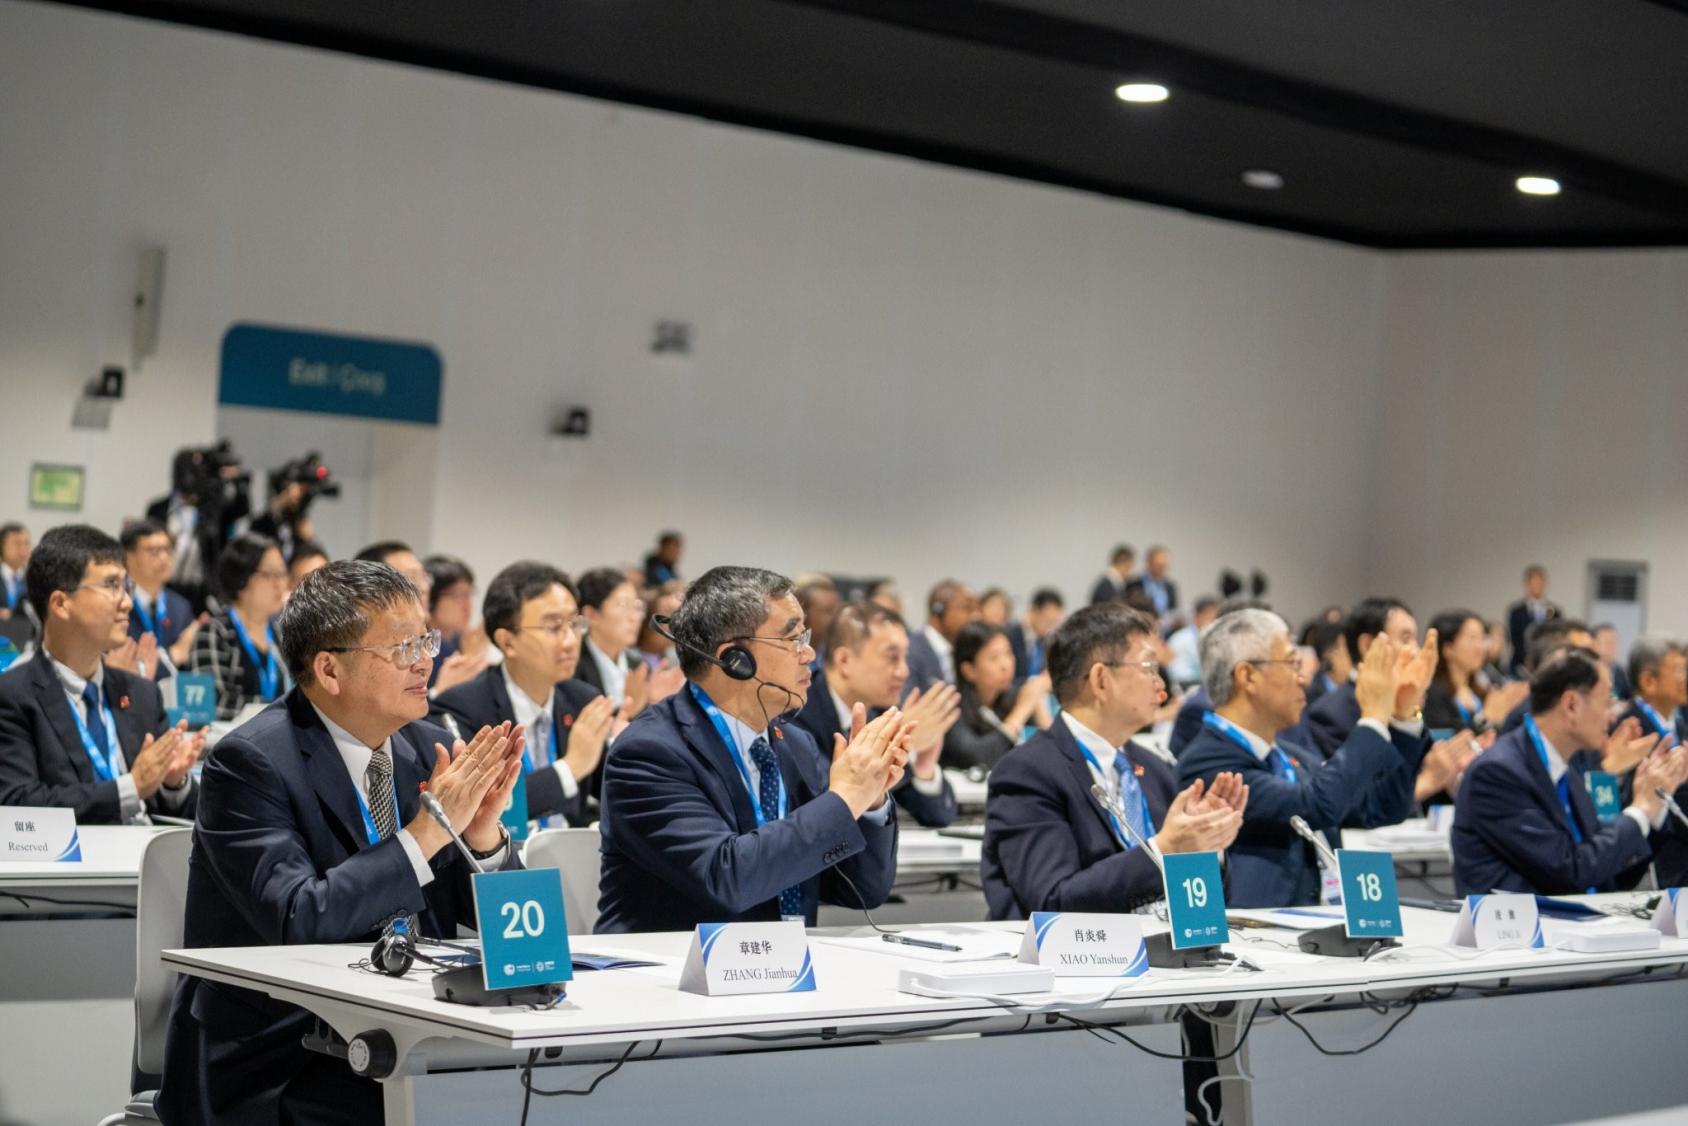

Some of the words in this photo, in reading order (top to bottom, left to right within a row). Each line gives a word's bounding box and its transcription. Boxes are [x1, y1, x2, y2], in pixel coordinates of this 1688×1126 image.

[184, 685, 205, 706] 77
[8, 841, 49, 852] Reserved
[1182, 877, 1208, 908] 19
[1356, 873, 1382, 902] 18
[501, 900, 545, 939] 20
[1074, 928, 1107, 942] 肖炎舜
[739, 940, 773, 955] 章建华
[1060, 954, 1088, 965] XIAO
[1089, 953, 1129, 965] Yanshun
[723, 967, 762, 981] ZHANG
[764, 966, 798, 979] Jianhua
